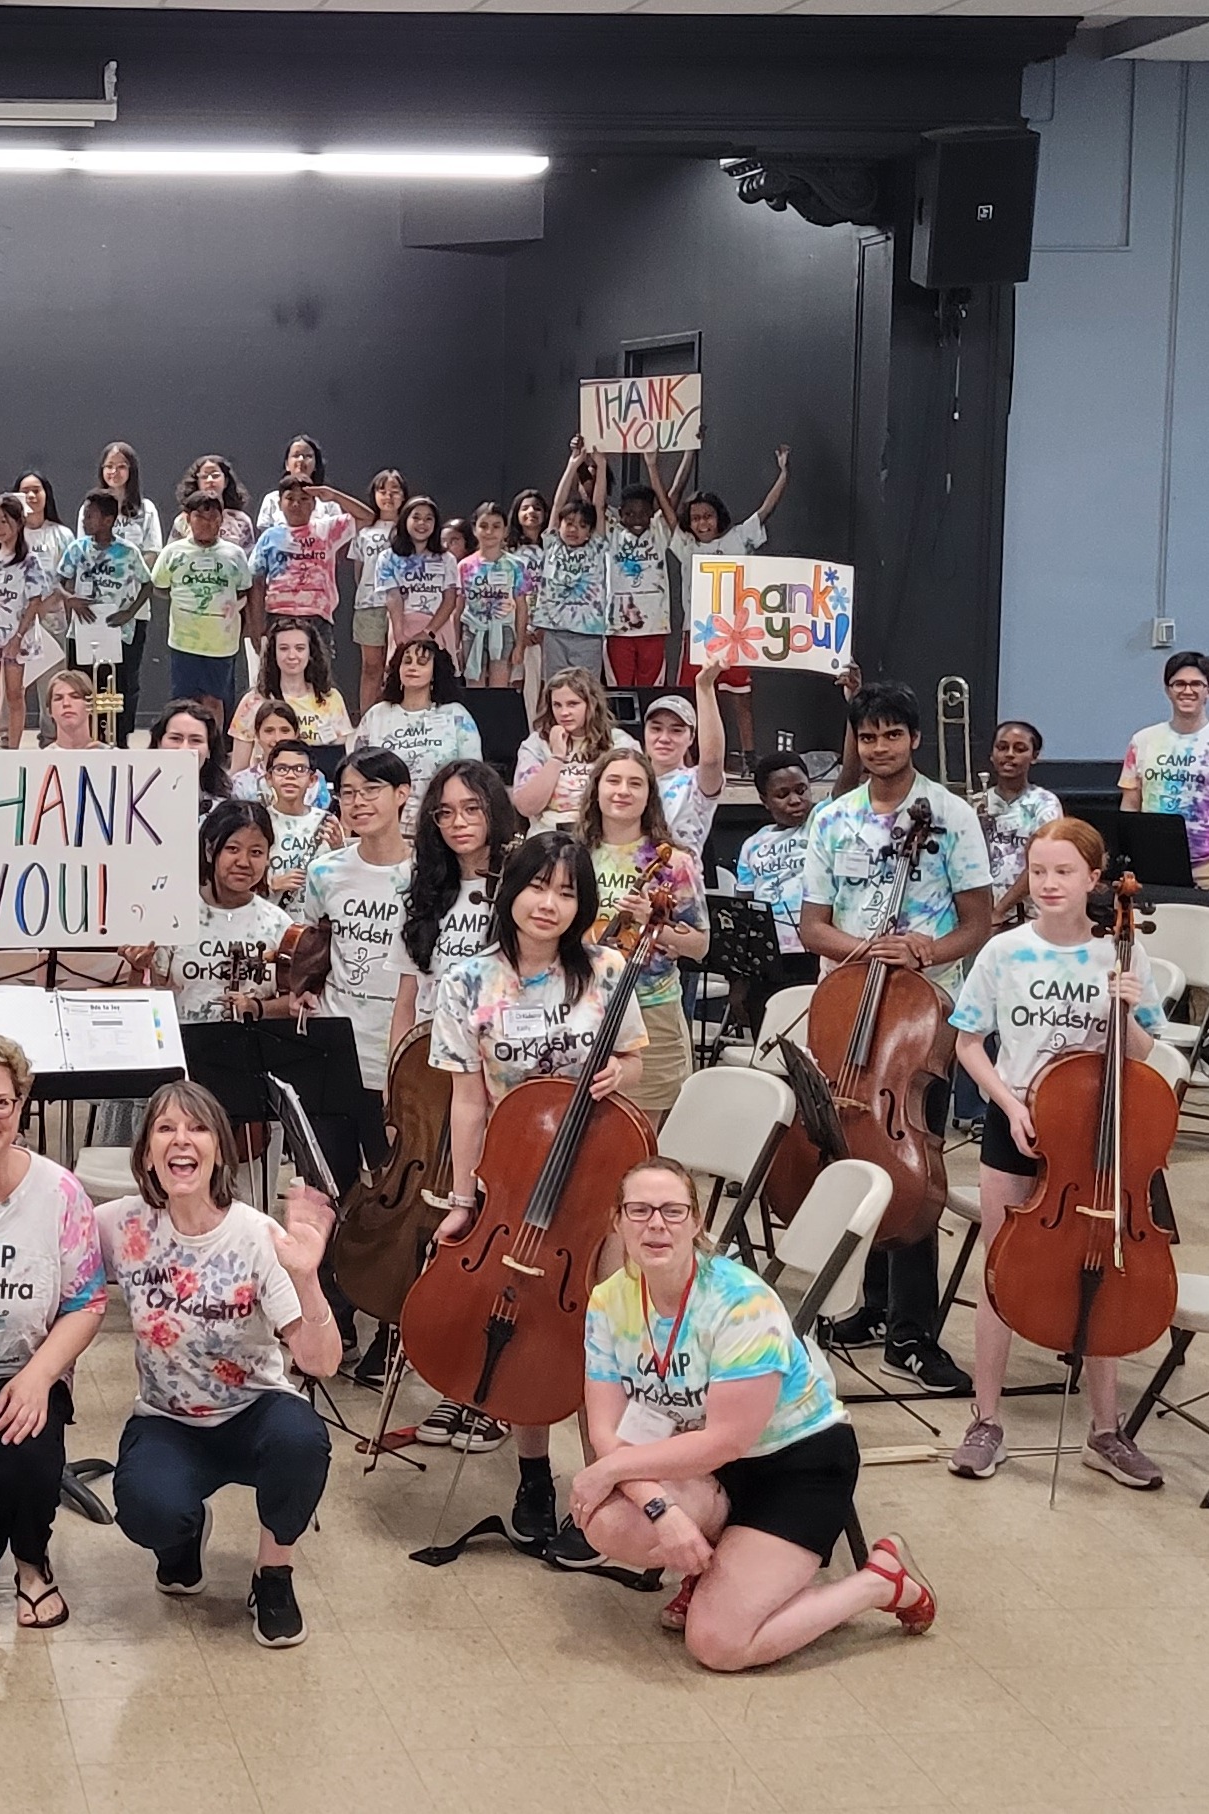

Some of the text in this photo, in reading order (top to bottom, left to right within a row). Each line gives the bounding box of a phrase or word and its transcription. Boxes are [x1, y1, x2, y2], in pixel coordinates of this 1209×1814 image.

[580, 375, 687, 439] THANK
[612, 405, 701, 450] YOU!
[190, 561, 223, 573] CP
[700, 561, 834, 620] Thank
[762, 613, 849, 669] you!
[1156, 754, 1197, 767] CAMP
[1144, 768, 1206, 784] OrKidstra
[597, 872, 636, 889] AMP
[343, 898, 399, 921] CAMP
[443, 913, 490, 933] AMP
[1029, 980, 1100, 1003] CAMP
[543, 1003, 571, 1027] MP
[1011, 1005, 1108, 1033] OrKidstra
[494, 1031, 595, 1062] OrKidstra
[132, 1266, 178, 1286] CAMP
